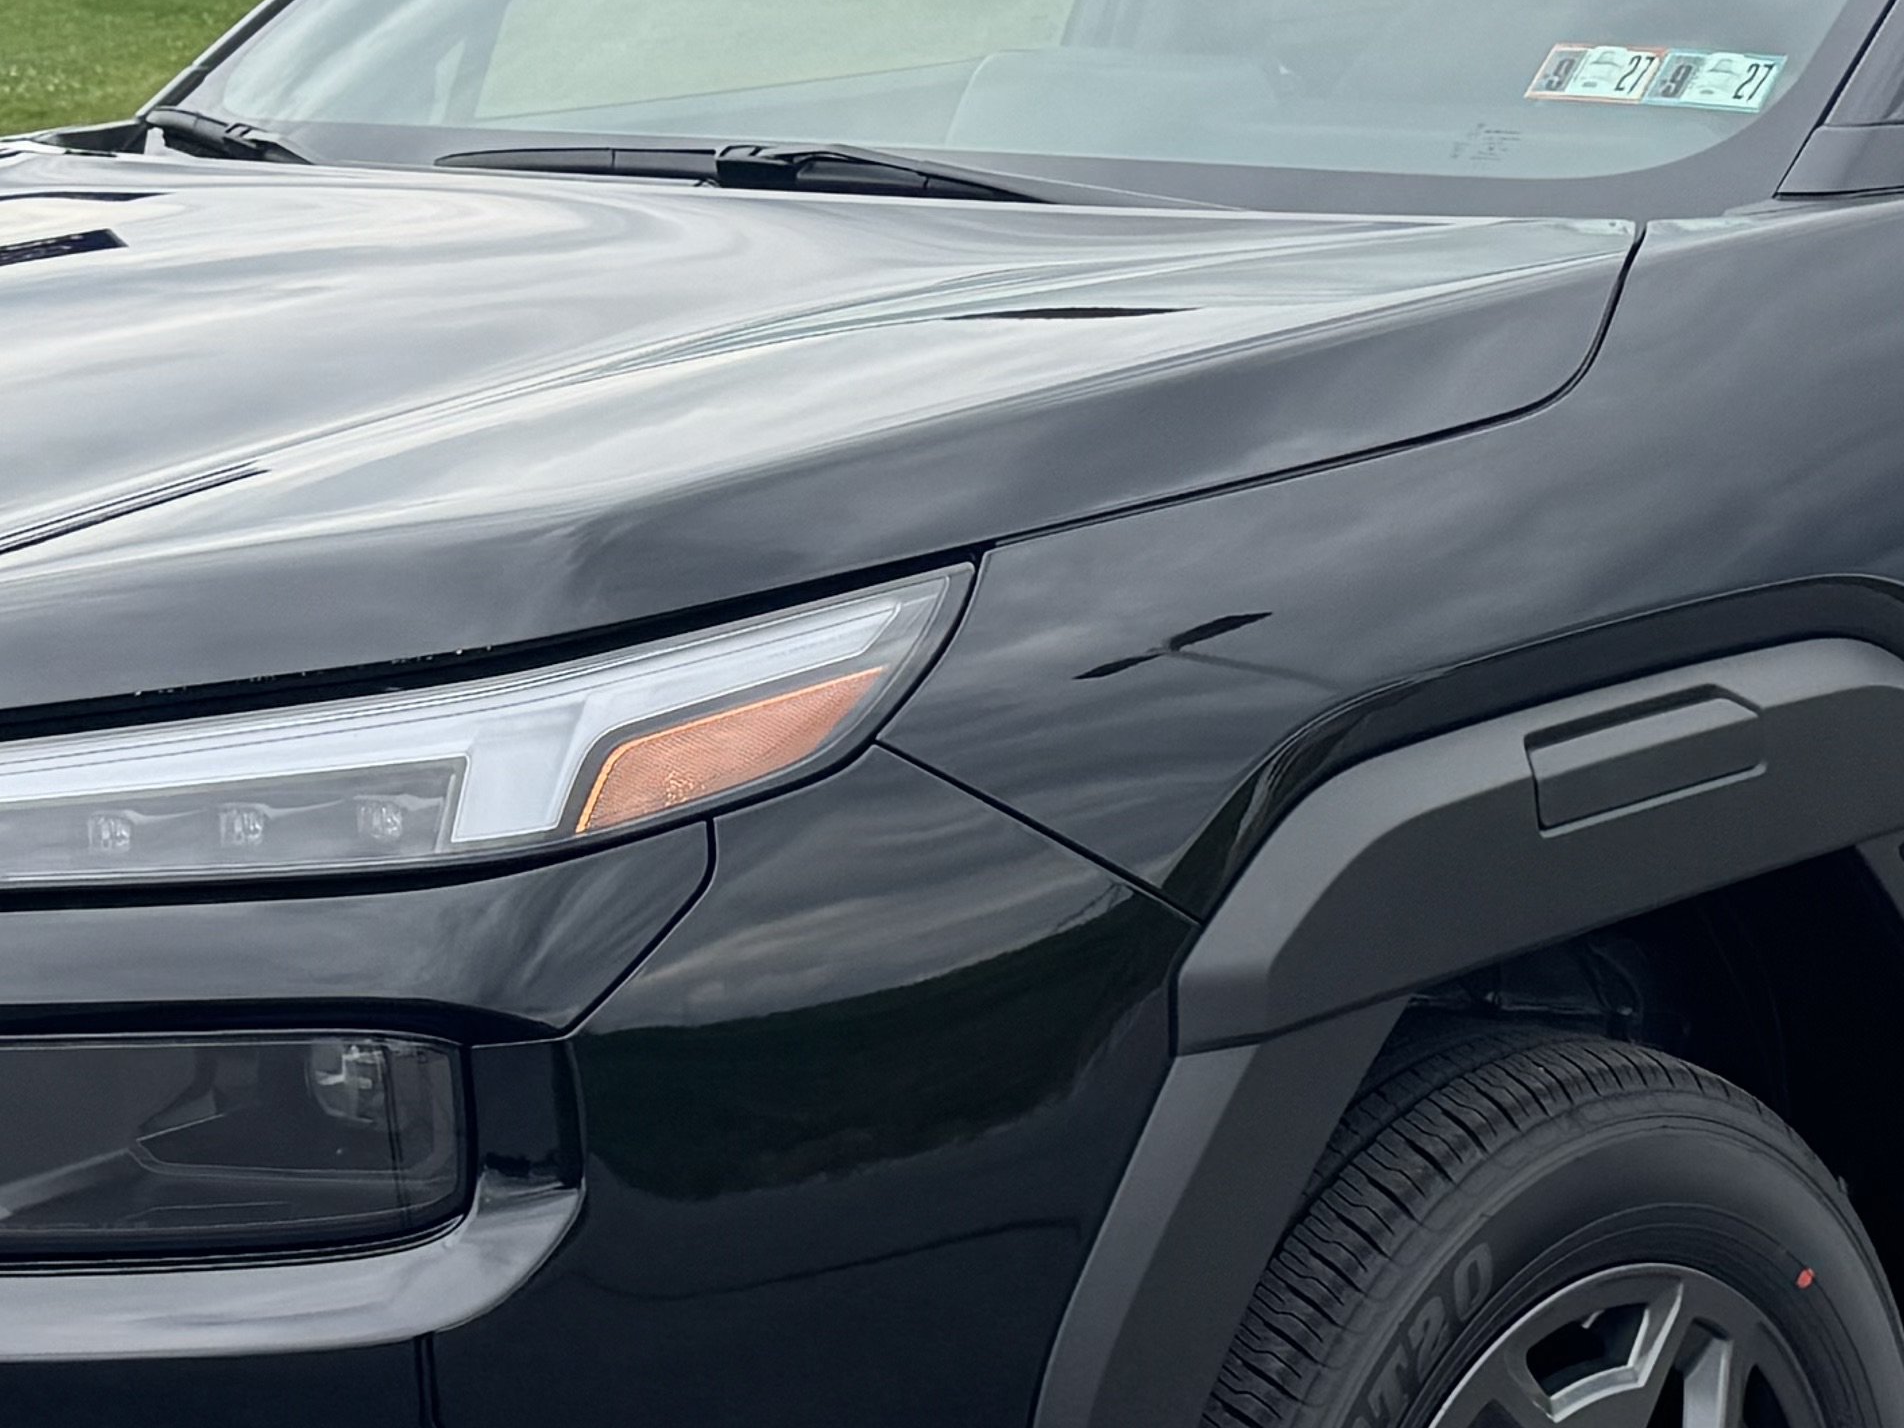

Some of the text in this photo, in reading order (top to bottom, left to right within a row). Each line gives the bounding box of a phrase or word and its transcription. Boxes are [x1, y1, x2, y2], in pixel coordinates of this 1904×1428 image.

[1614, 54, 1655, 94] 27
[1661, 62, 1776, 102] 9 27
